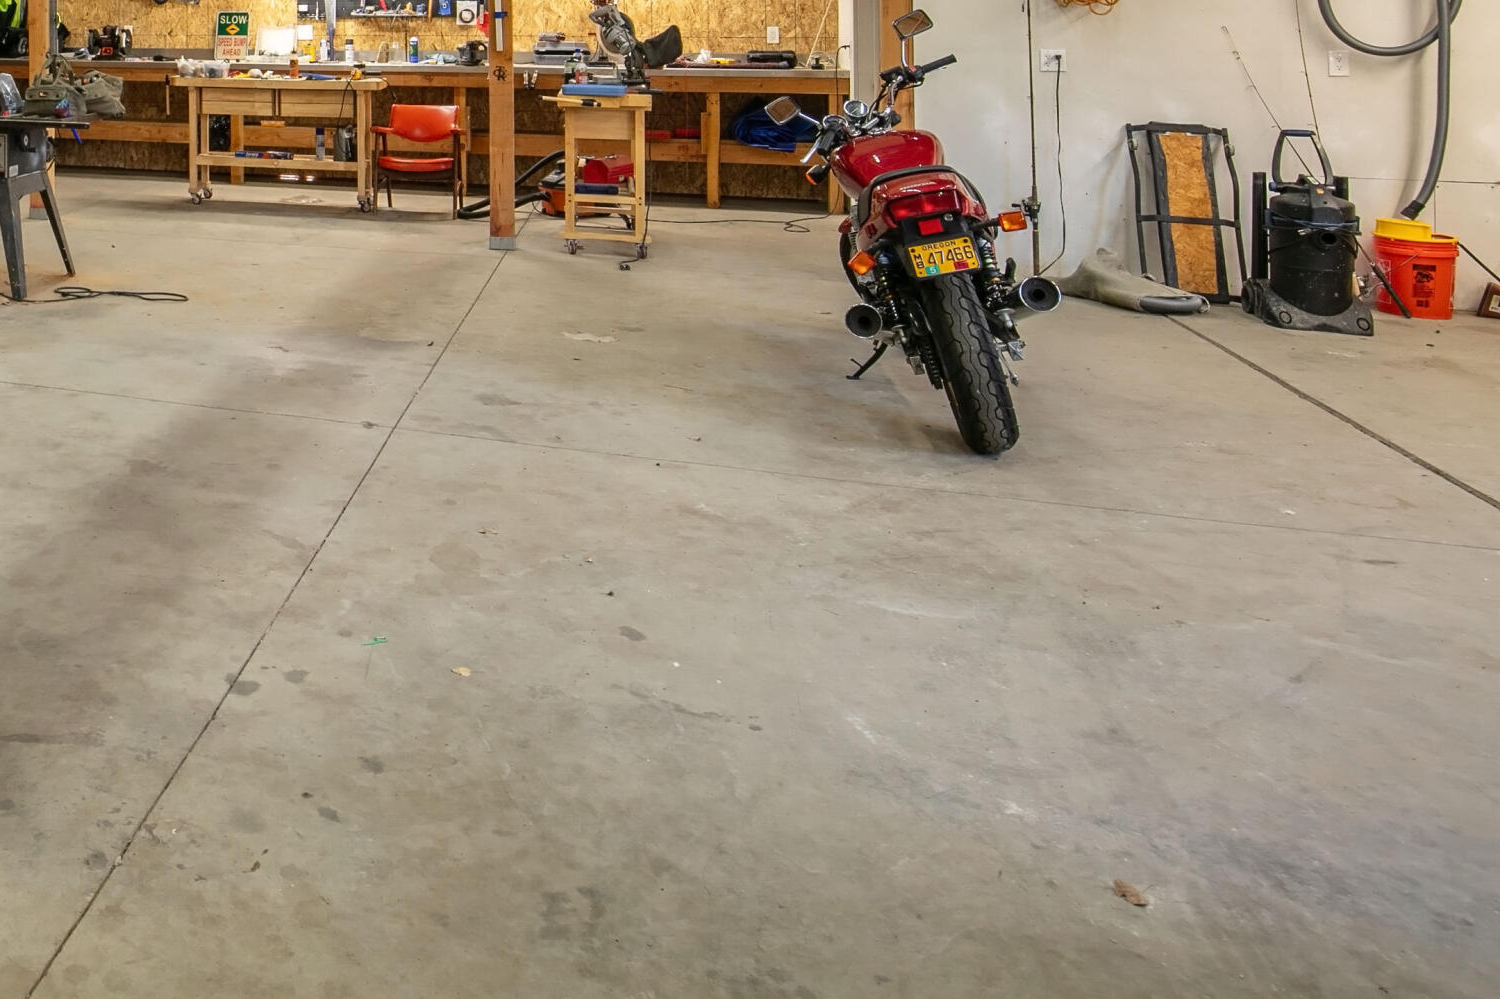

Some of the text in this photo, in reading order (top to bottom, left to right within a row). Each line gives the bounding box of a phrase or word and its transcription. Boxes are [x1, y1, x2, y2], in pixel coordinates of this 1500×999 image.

[220, 15, 248, 24] SLOW
[217, 37, 247, 46] SPEED BUMP
[222, 48, 241, 56] AHEAD
[921, 240, 957, 251] OREGON
[928, 245, 974, 265] 47466
